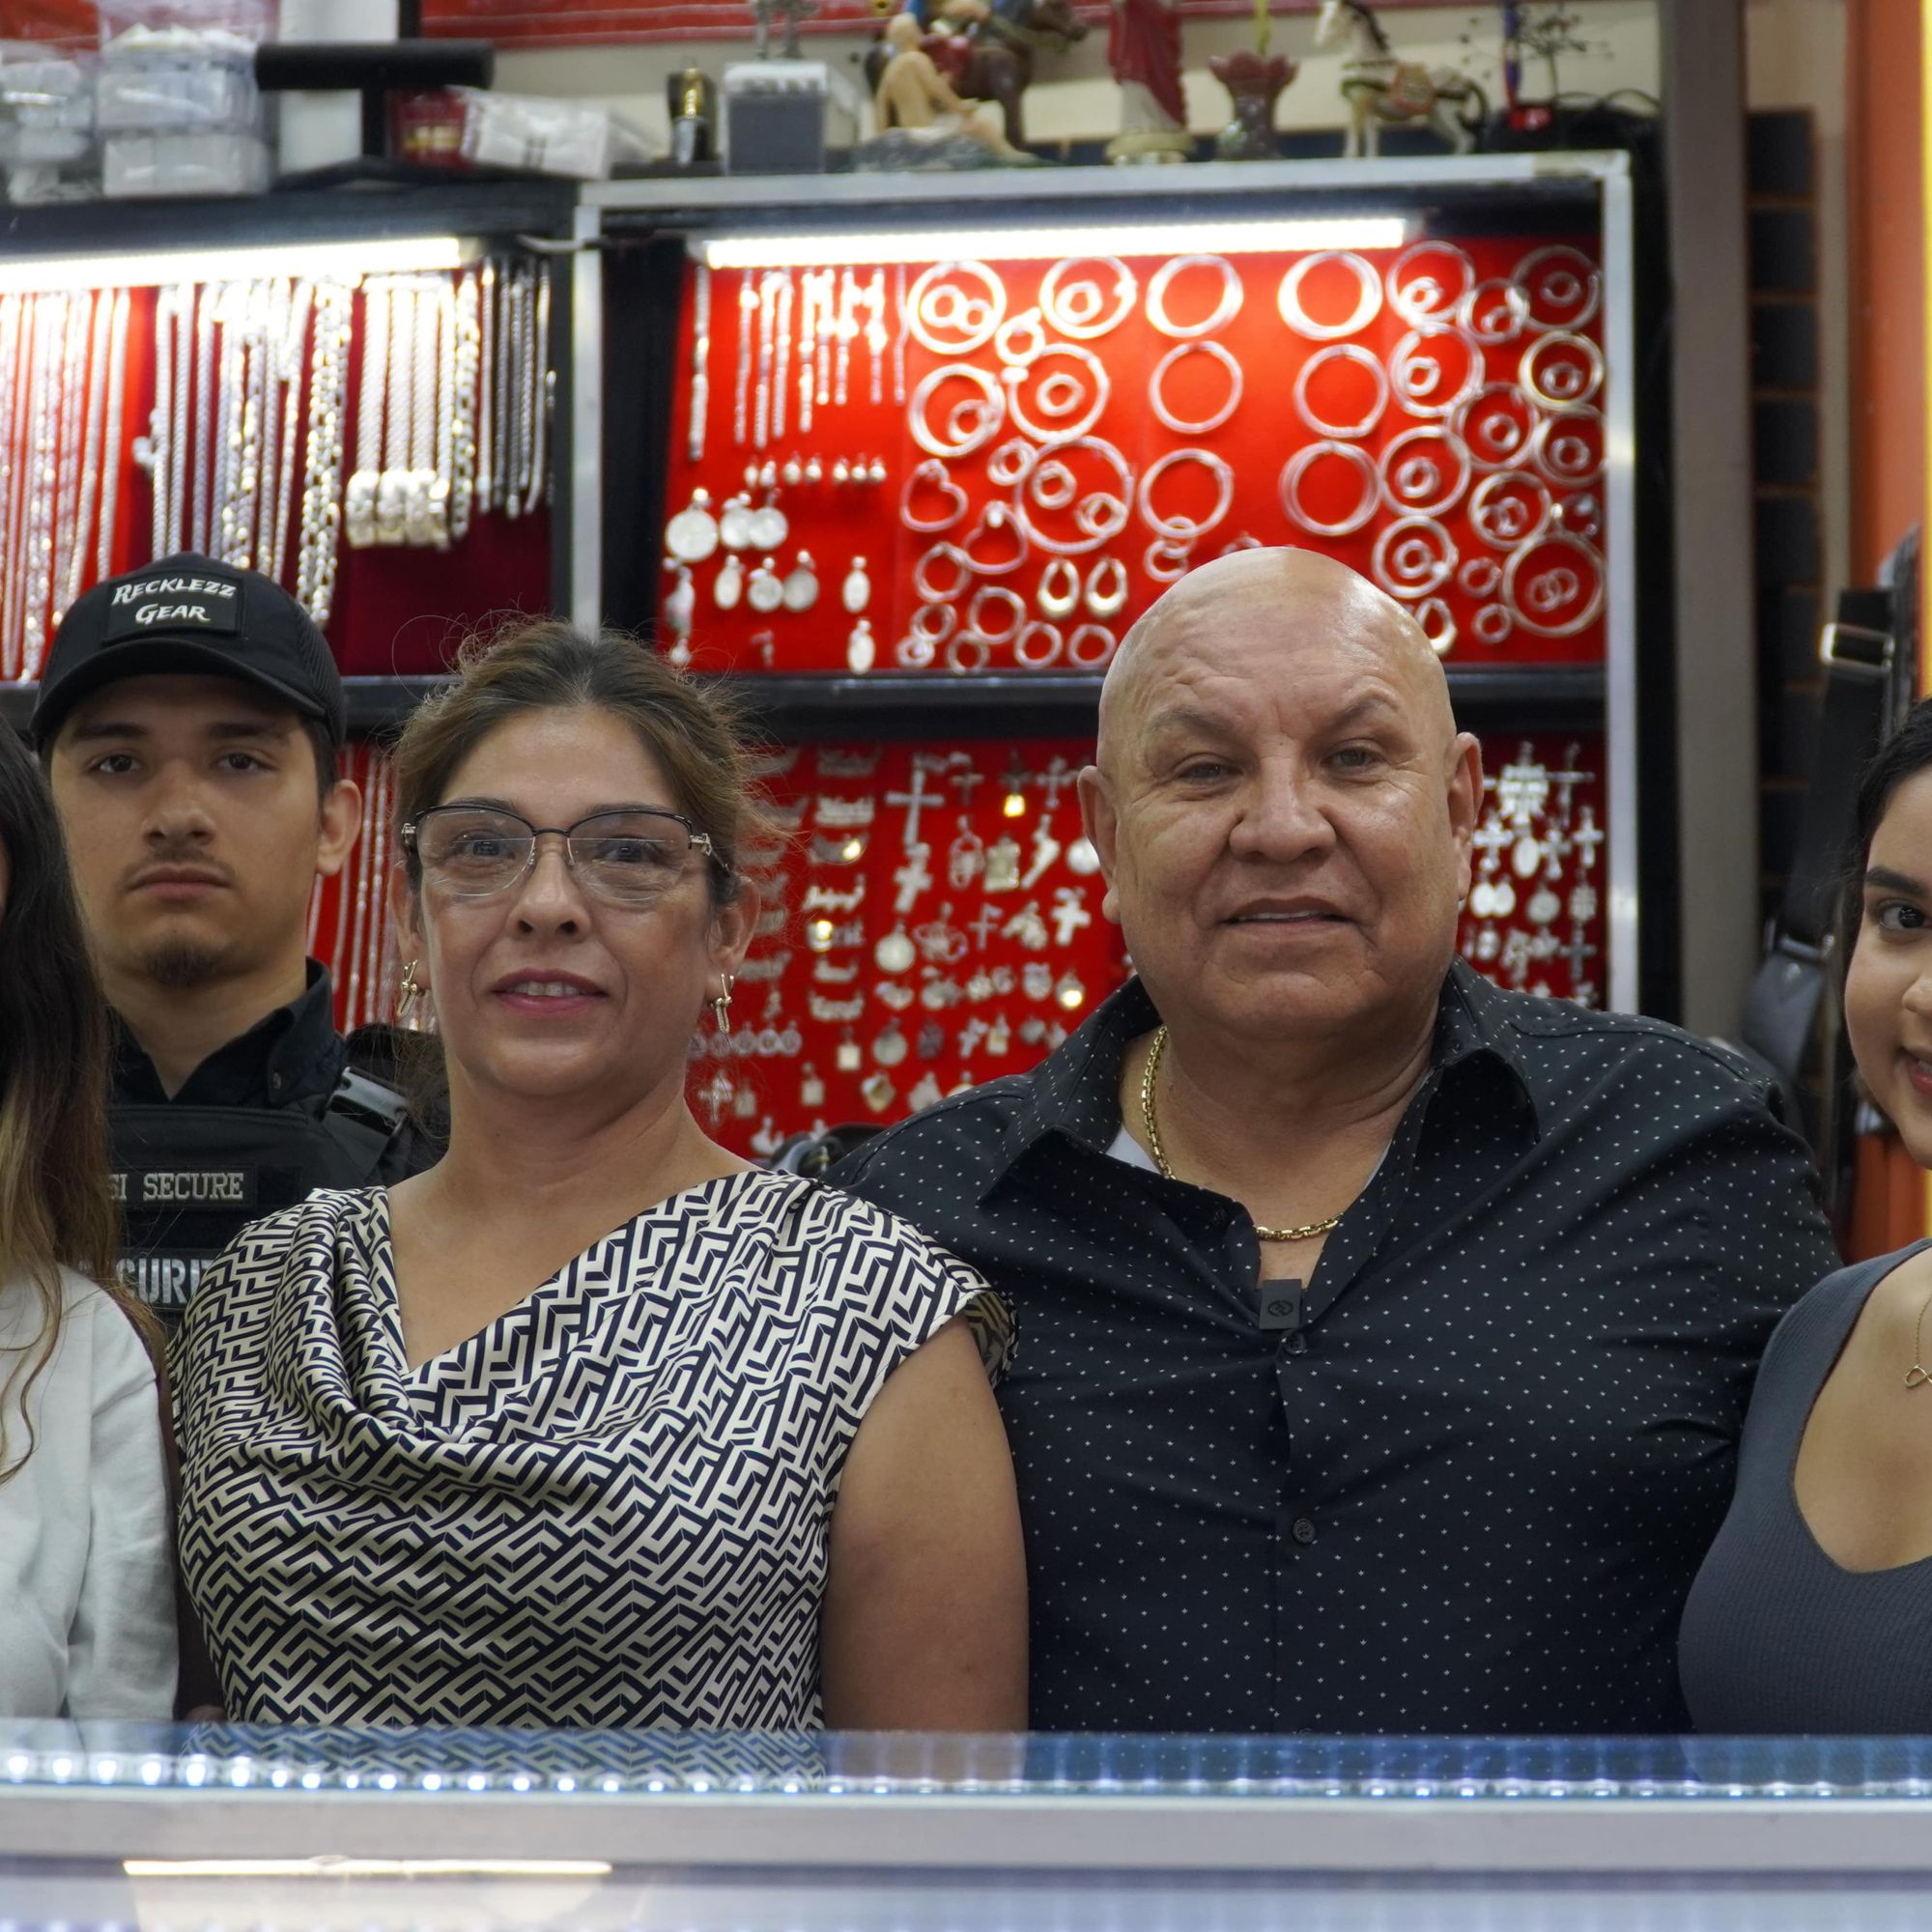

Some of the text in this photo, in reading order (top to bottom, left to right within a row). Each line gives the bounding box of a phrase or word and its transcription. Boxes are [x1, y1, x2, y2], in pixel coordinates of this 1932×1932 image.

[111, 578, 238, 606] RECKLEZZ
[135, 603, 212, 625] GEAR
[142, 1172, 244, 1201] SECURE
